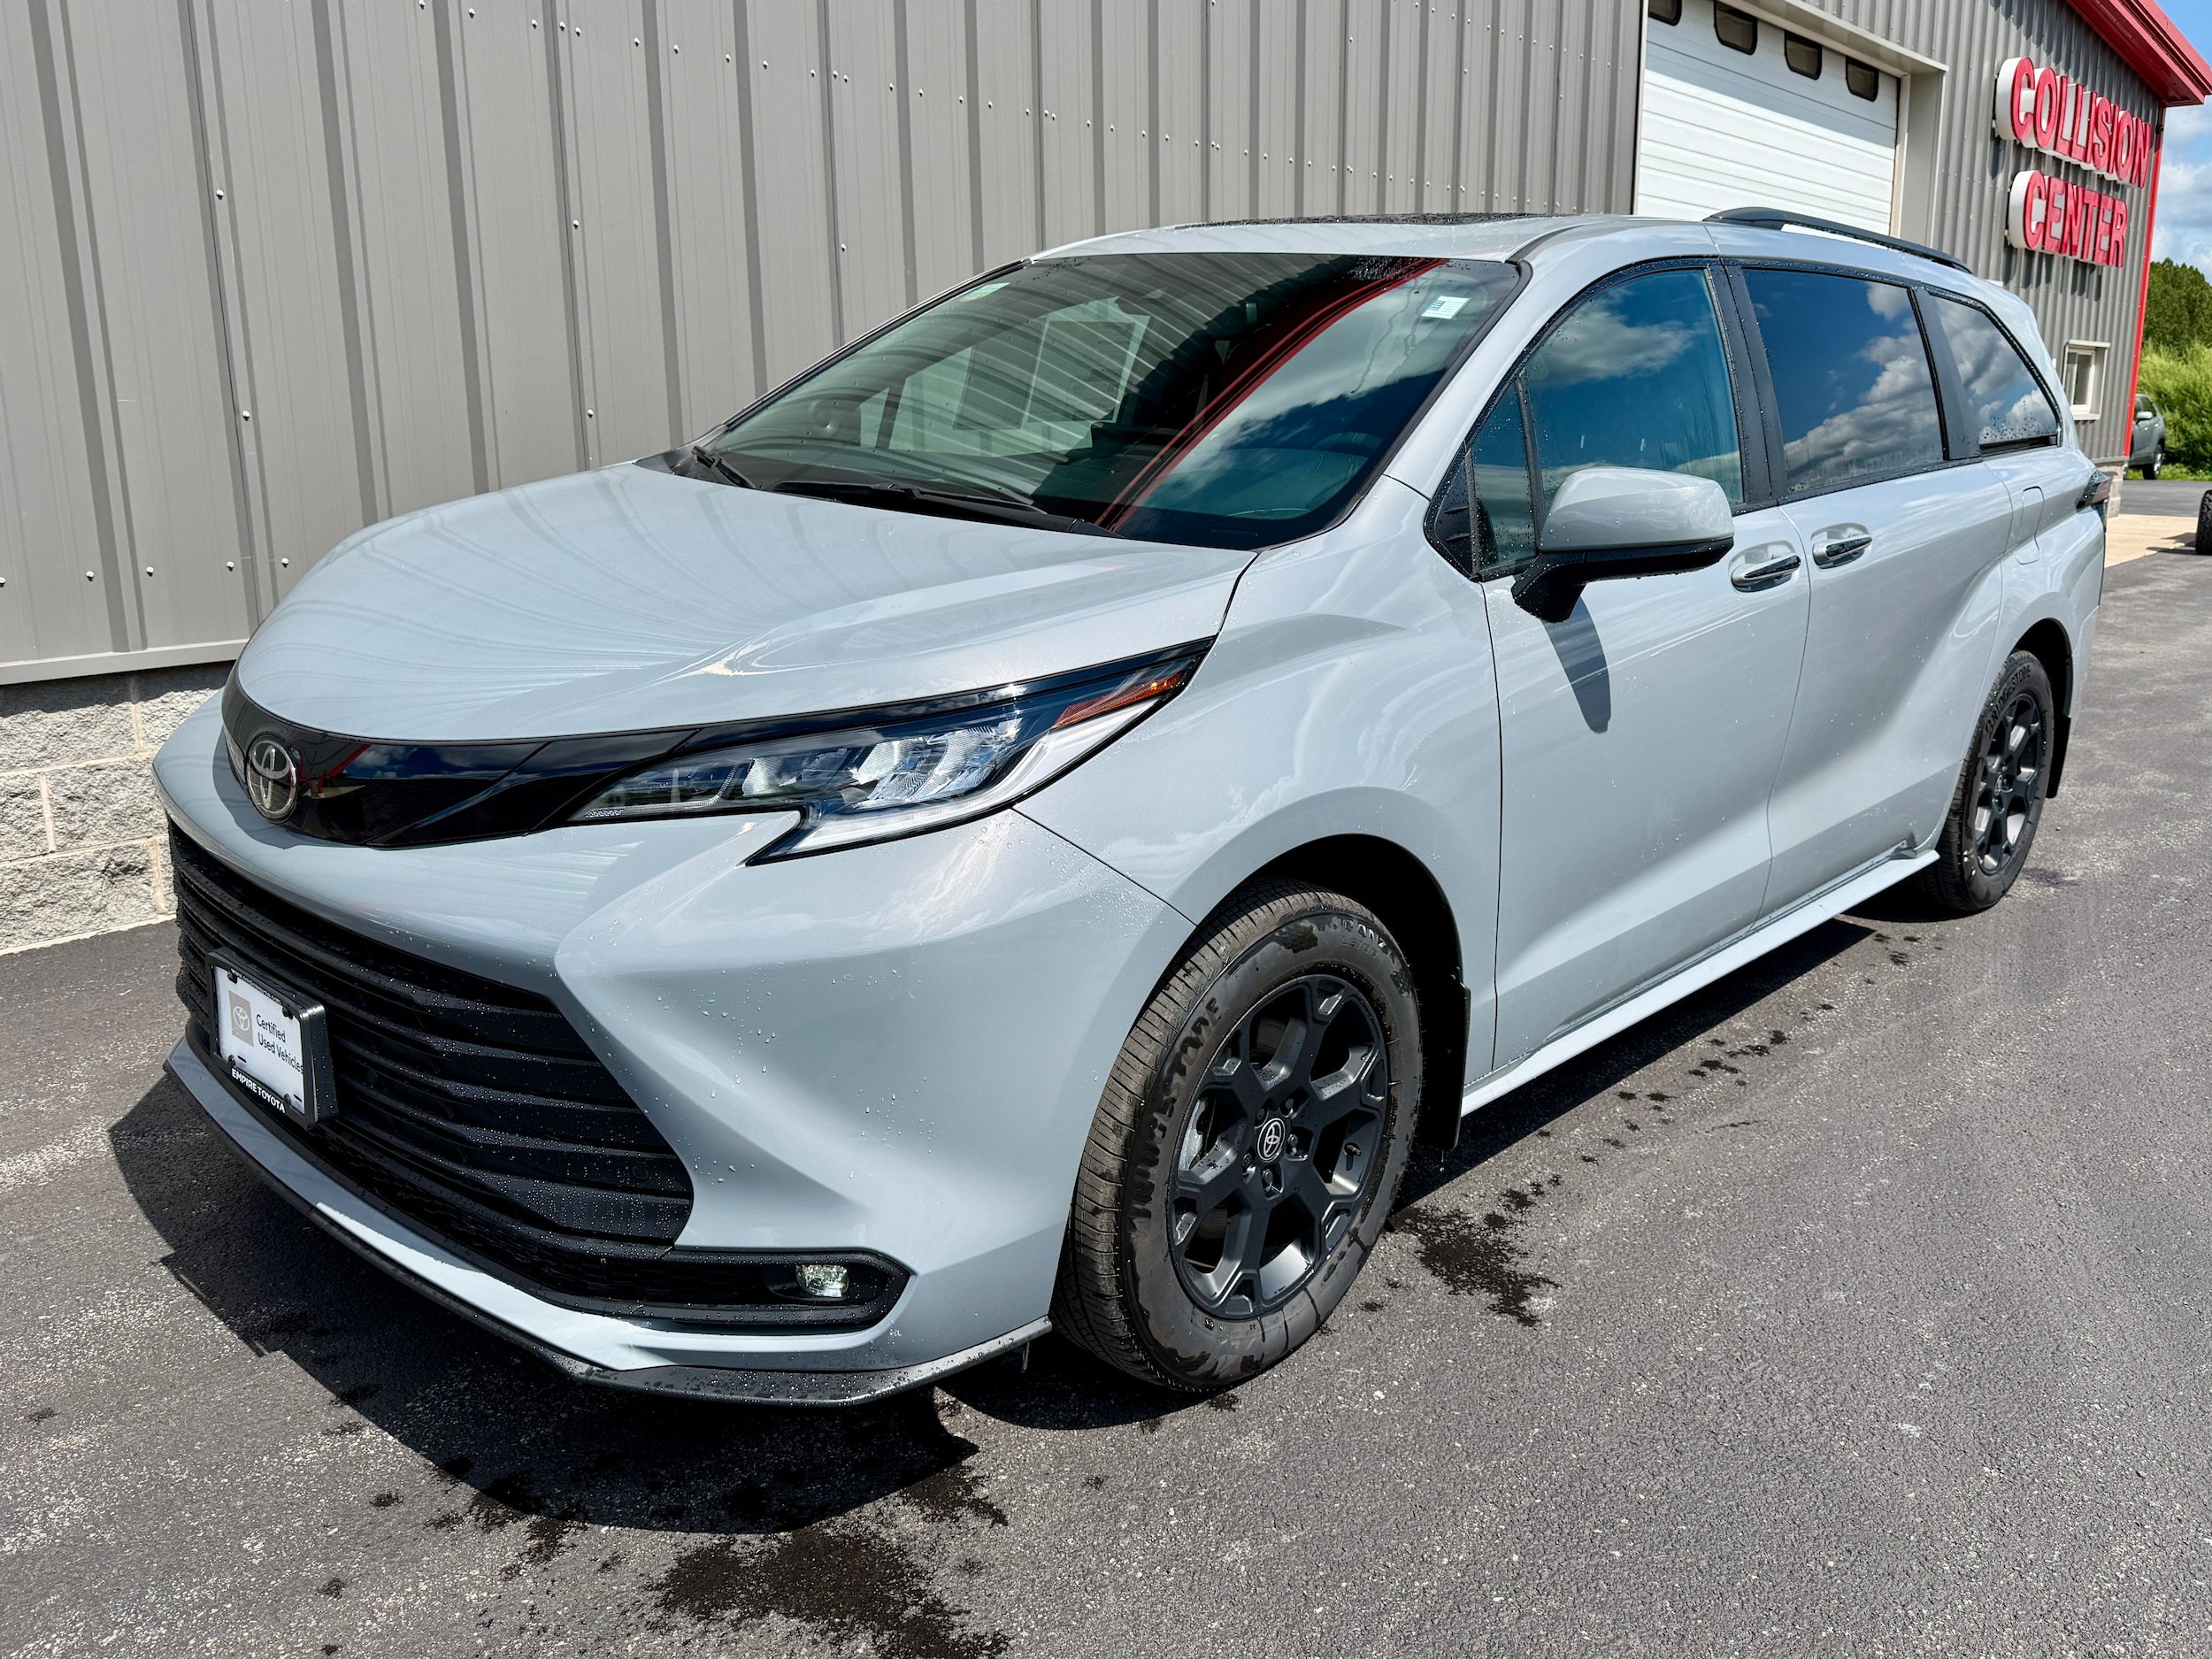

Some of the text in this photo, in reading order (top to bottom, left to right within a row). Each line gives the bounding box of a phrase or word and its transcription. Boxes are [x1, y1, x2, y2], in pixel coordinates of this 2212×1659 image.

[2010, 56, 2152, 188] COLLISION
[2023, 169, 2128, 268] CENTER
[256, 1014, 286, 1043] Certified
[257, 1032, 304, 1074] Used Vehicles
[232, 1068, 285, 1113] EMPIRE TOYOTA
